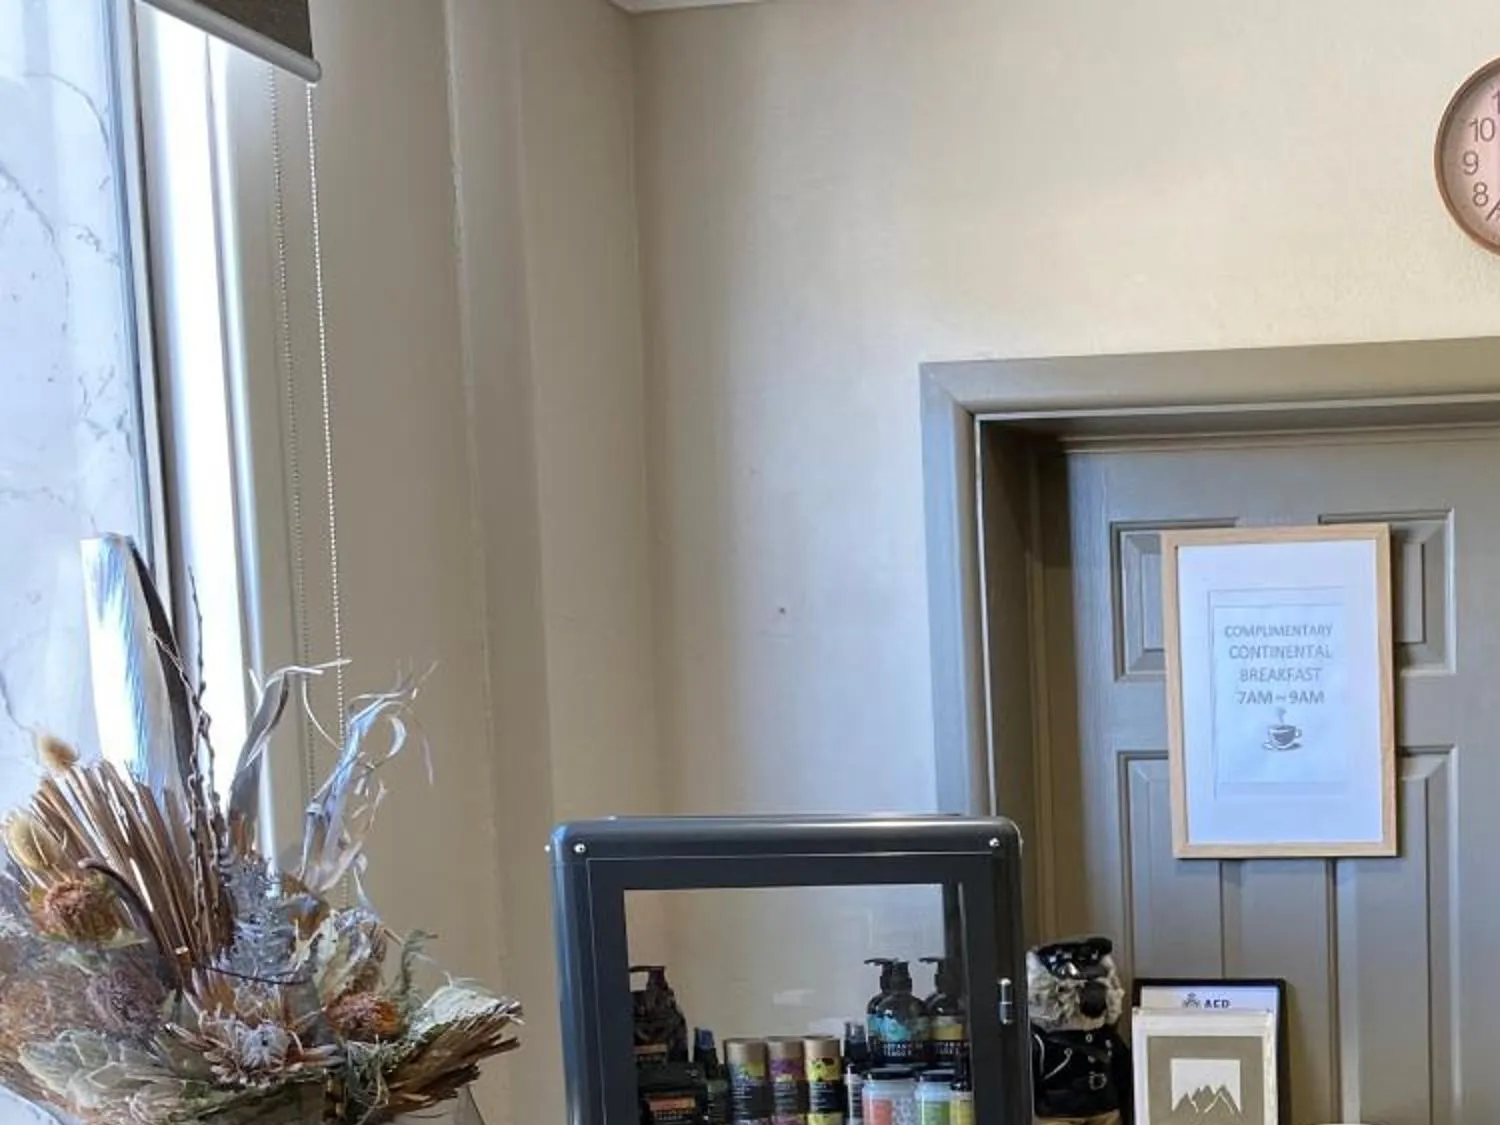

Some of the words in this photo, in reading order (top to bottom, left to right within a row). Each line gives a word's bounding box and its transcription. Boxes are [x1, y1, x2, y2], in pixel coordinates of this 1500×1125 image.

[1469, 117, 1496, 142] 10
[1462, 150, 1479, 175] 9
[1472, 182, 1489, 207] 8
[1224, 623, 1334, 639] COMPLIMENTARY
[1229, 644, 1334, 660] CONTINENTAL
[1240, 666, 1324, 683] BREAKFAST
[1235, 689, 1274, 705] 7AM
[1288, 689, 1326, 705] 9AM
